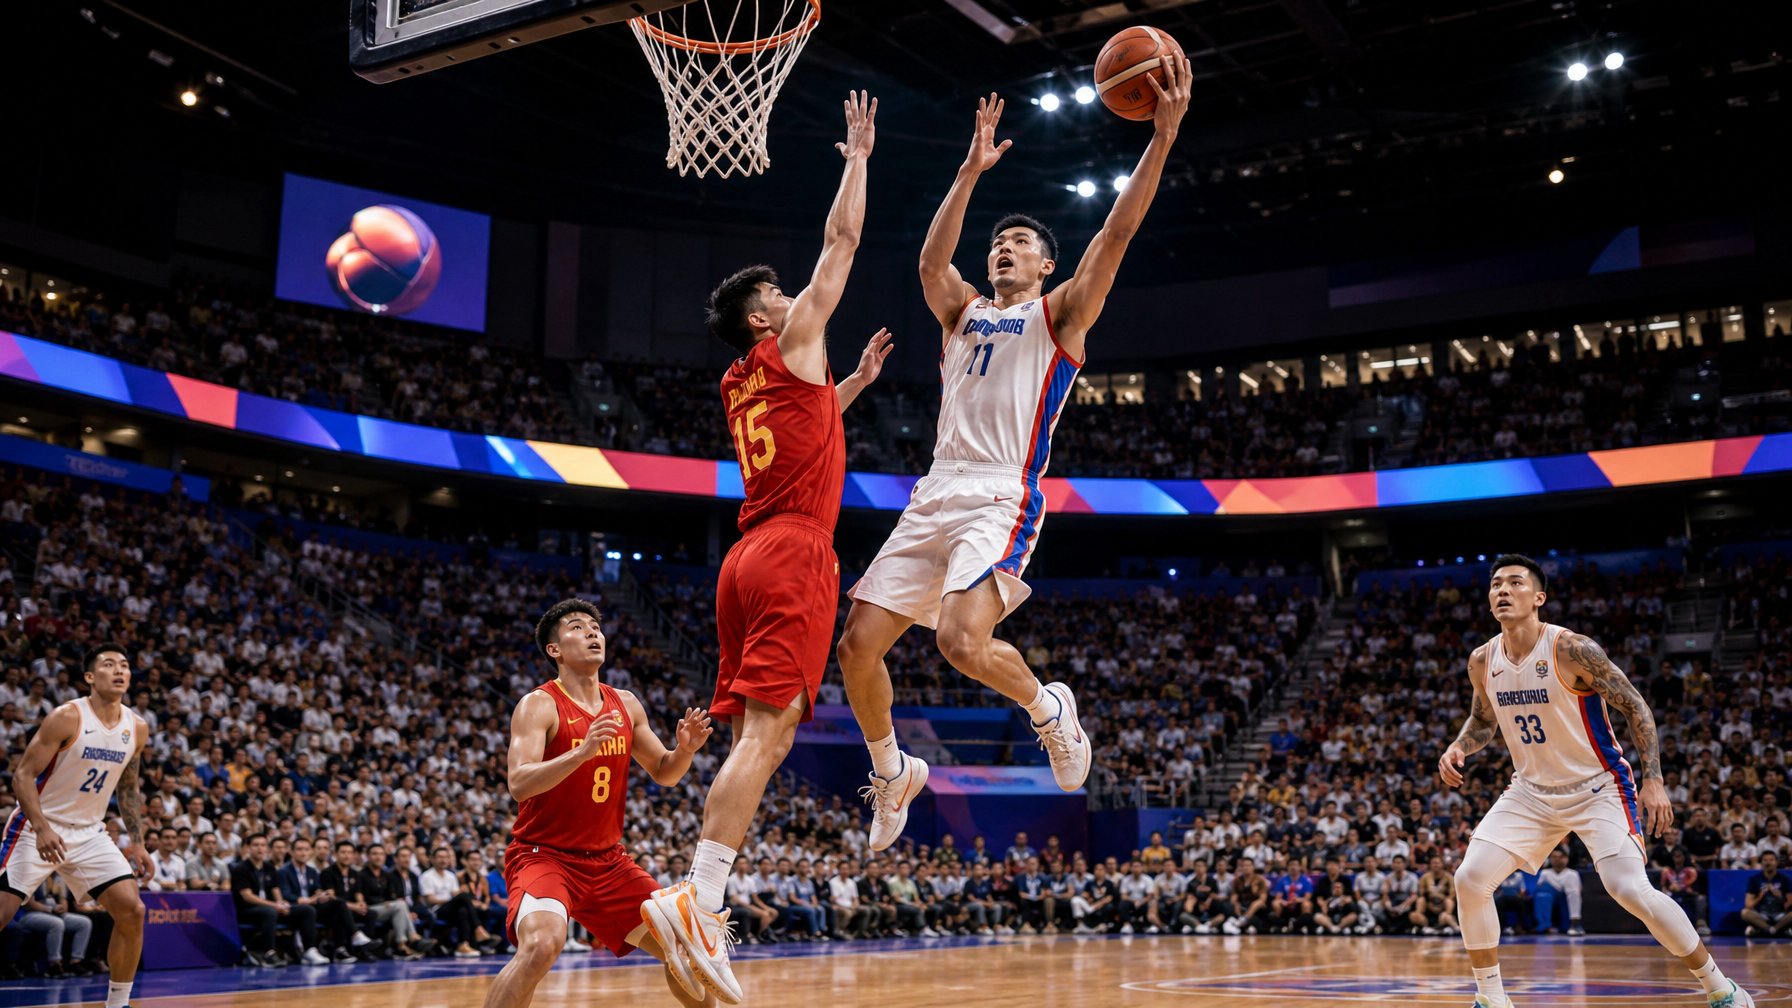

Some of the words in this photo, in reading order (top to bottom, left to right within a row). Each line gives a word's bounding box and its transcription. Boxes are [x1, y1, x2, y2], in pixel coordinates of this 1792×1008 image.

[967, 343, 994, 376] 11
[734, 400, 776, 480] 15
[1514, 714, 1547, 745] 33
[79, 768, 109, 794] 24
[591, 766, 611, 803] 8
